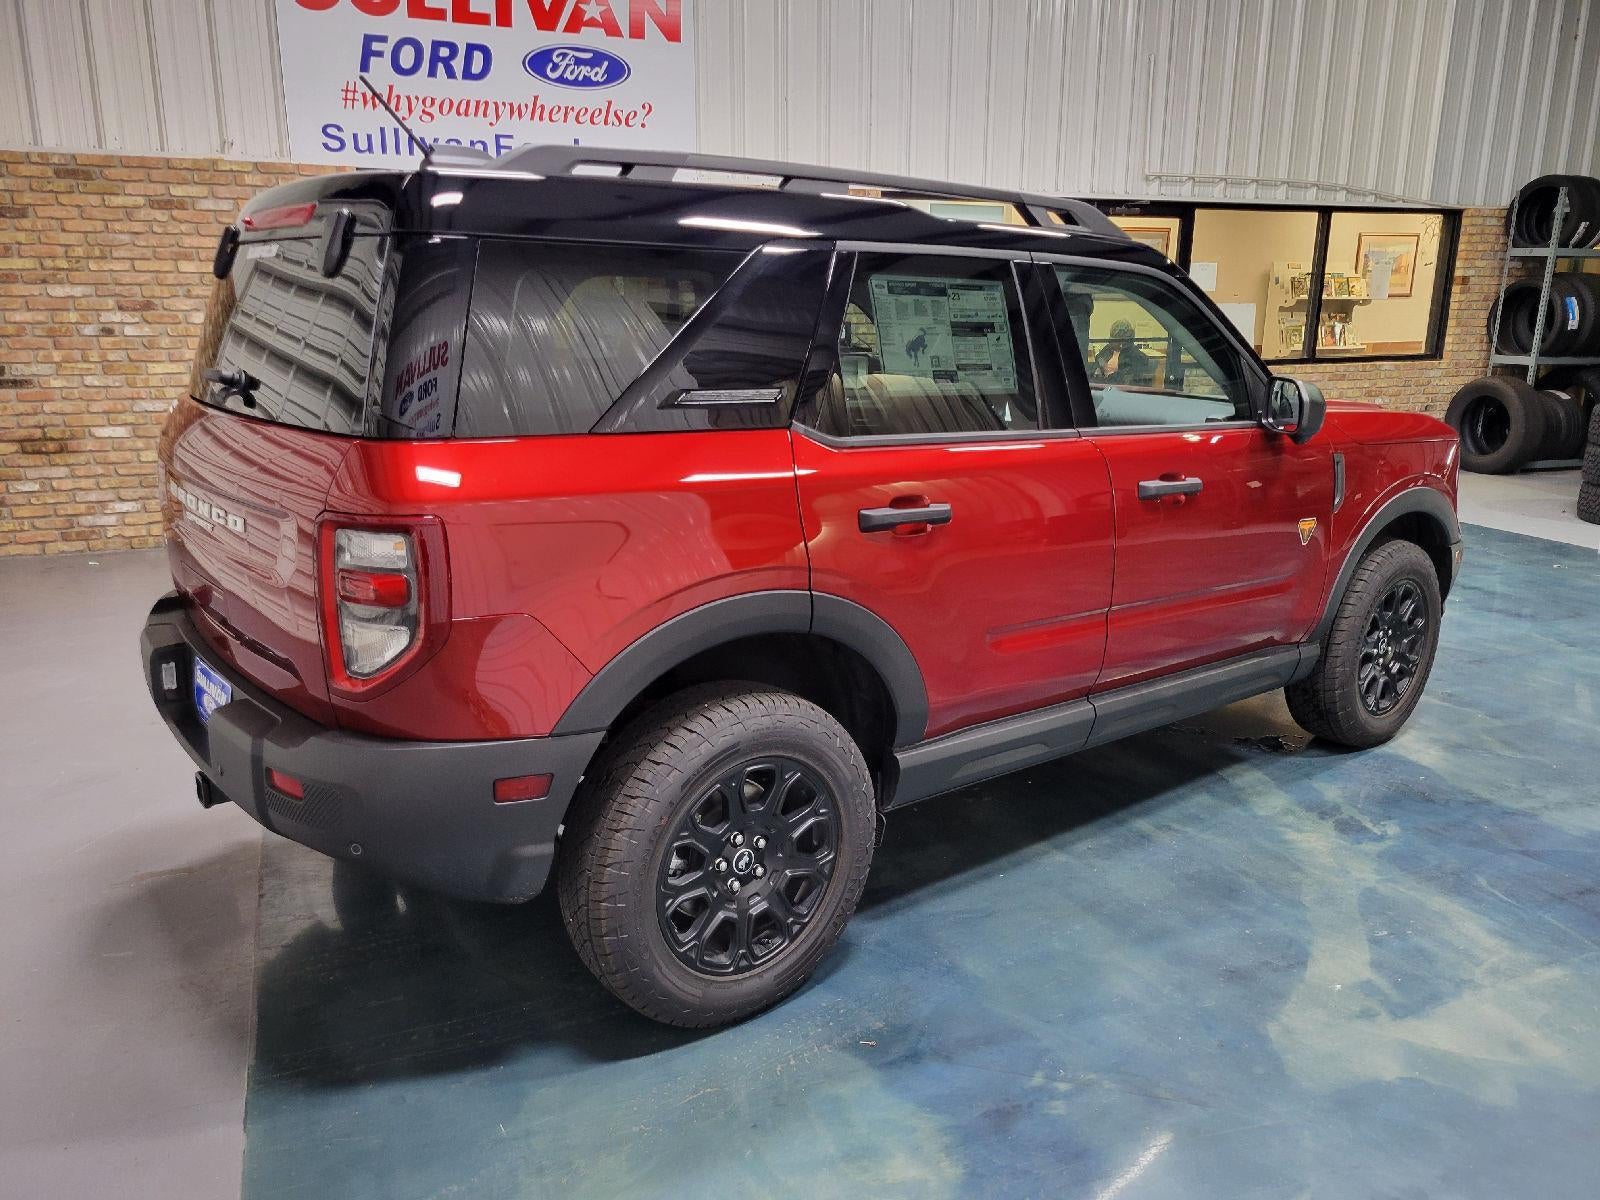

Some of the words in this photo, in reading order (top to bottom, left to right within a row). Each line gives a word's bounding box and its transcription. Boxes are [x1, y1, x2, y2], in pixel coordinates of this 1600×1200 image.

[294, 0, 682, 43] IVAN
[359, 33, 493, 81] FORD
[546, 49, 609, 82] Ford
[341, 80, 653, 128] #whygoanywhereelse?
